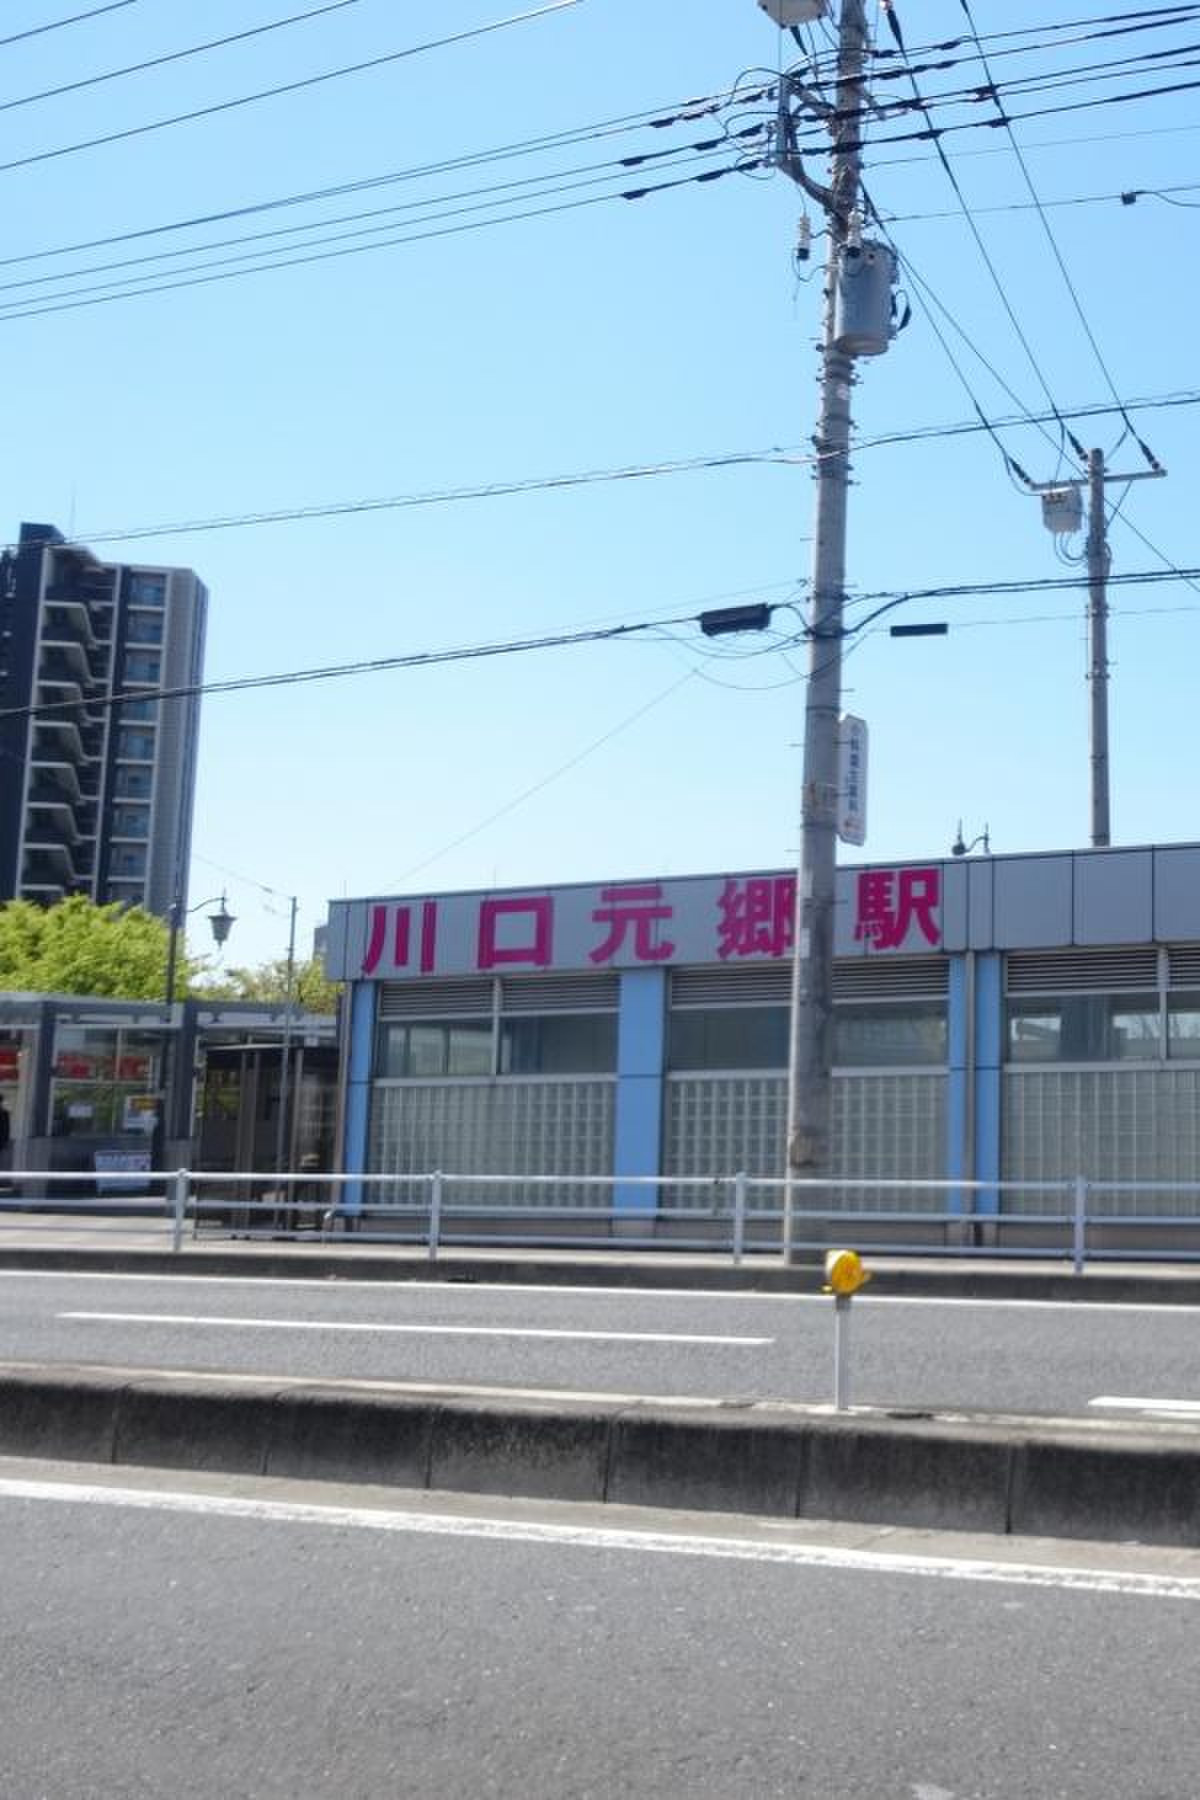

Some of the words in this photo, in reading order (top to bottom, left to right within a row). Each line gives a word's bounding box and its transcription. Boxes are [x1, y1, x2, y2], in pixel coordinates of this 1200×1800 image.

[361, 868, 941, 976] 川口元郷駅
